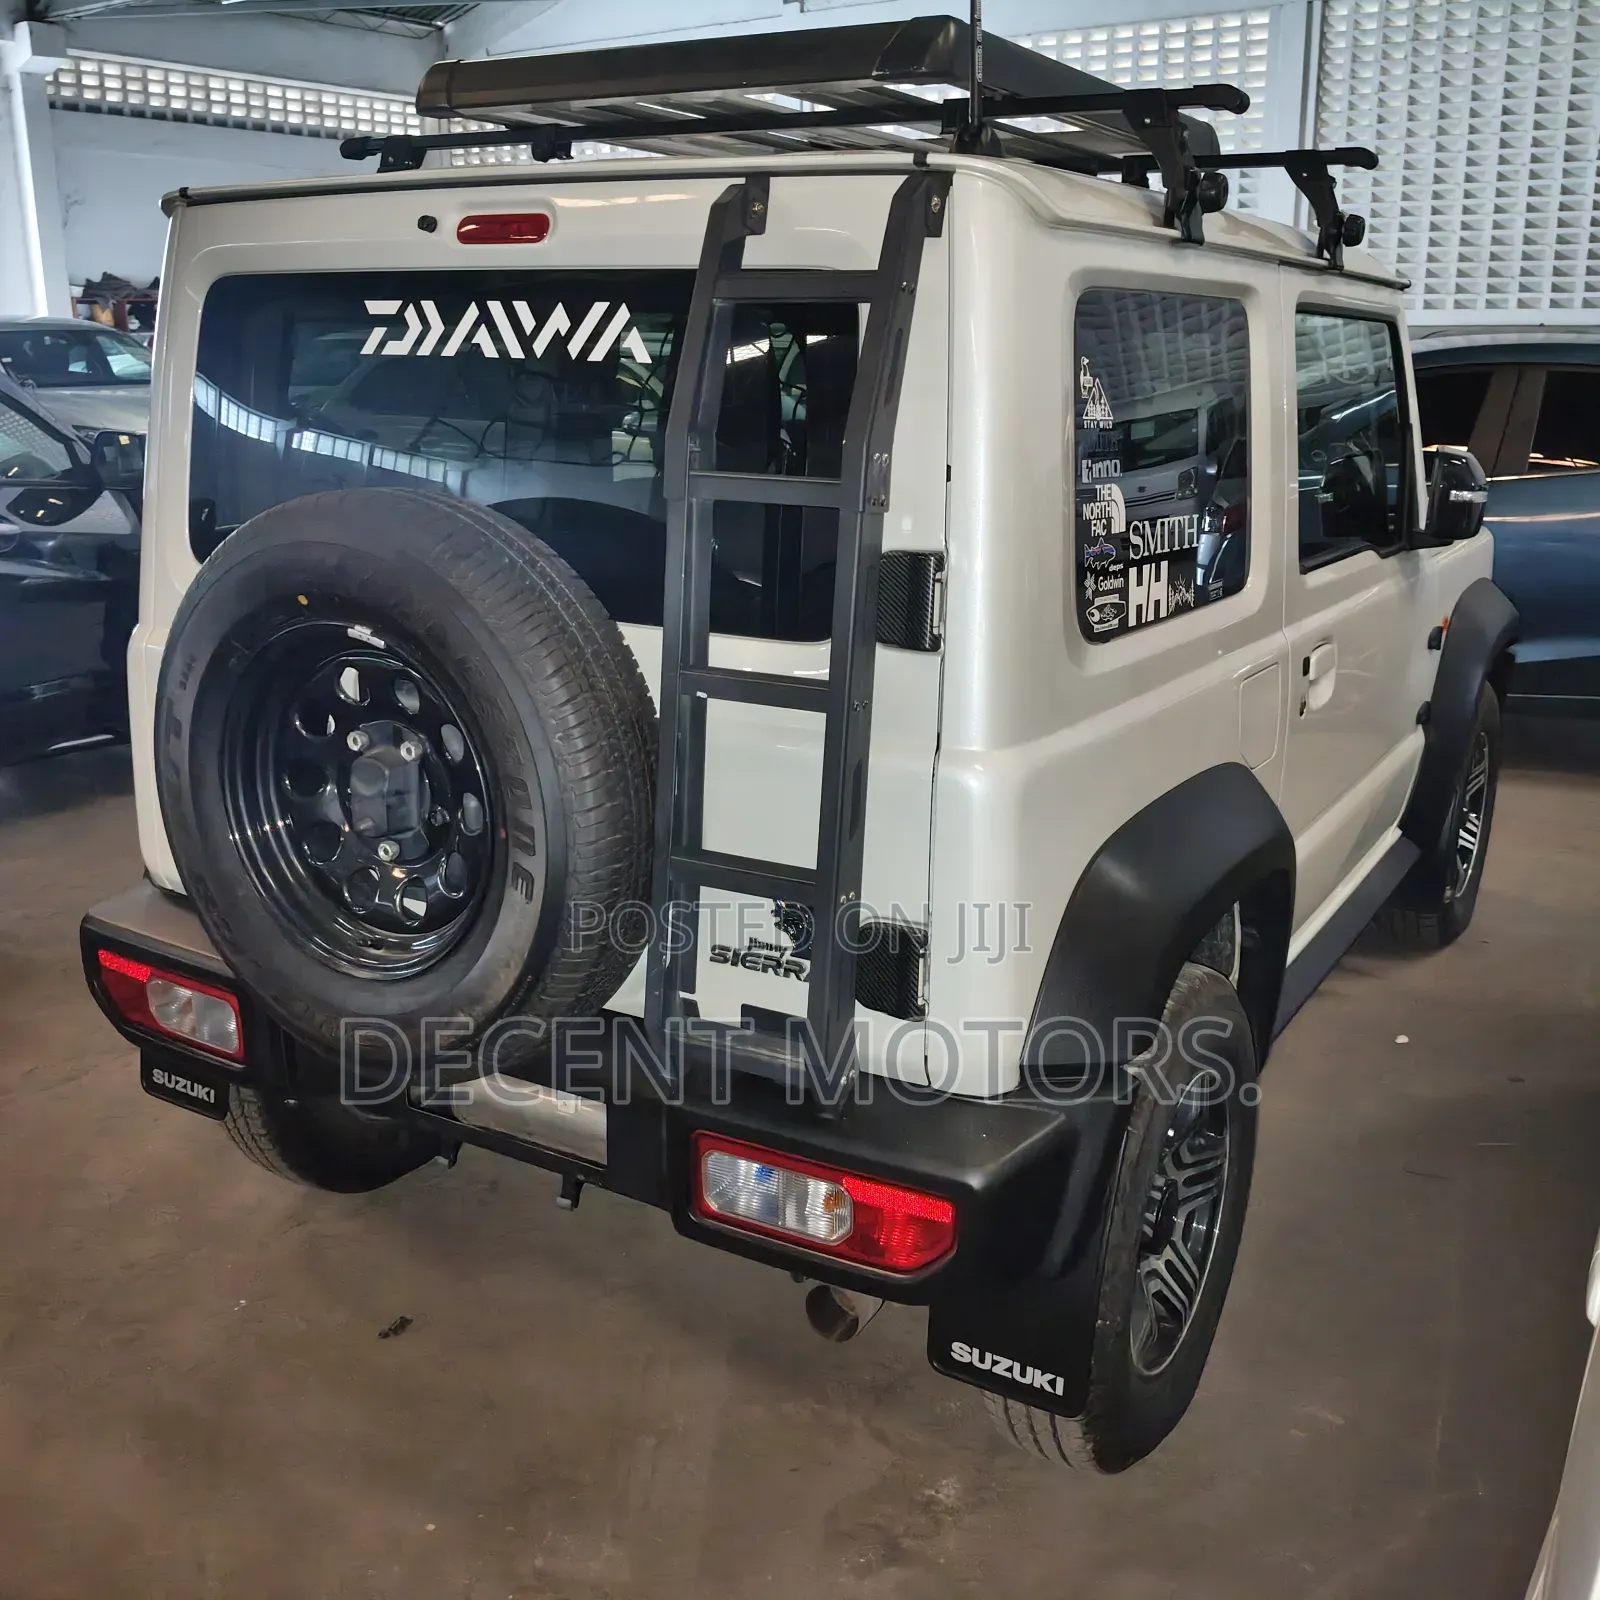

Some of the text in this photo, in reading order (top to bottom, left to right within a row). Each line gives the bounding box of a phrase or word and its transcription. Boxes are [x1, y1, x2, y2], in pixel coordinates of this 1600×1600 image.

[1083, 420, 1113, 429] STAY WILD
[1095, 483, 1112, 501] THE
[1082, 501, 1112, 521] NORTH
[1129, 514, 1199, 560] SMITH
[1108, 563, 1124, 572] deps
[1097, 577, 1124, 592] Goldwin
[1128, 560, 1169, 627] HH
[709, 943, 811, 982] SIERR
[152, 1068, 215, 1104] SUZUKI
[950, 1341, 1065, 1397] SUZUKI
